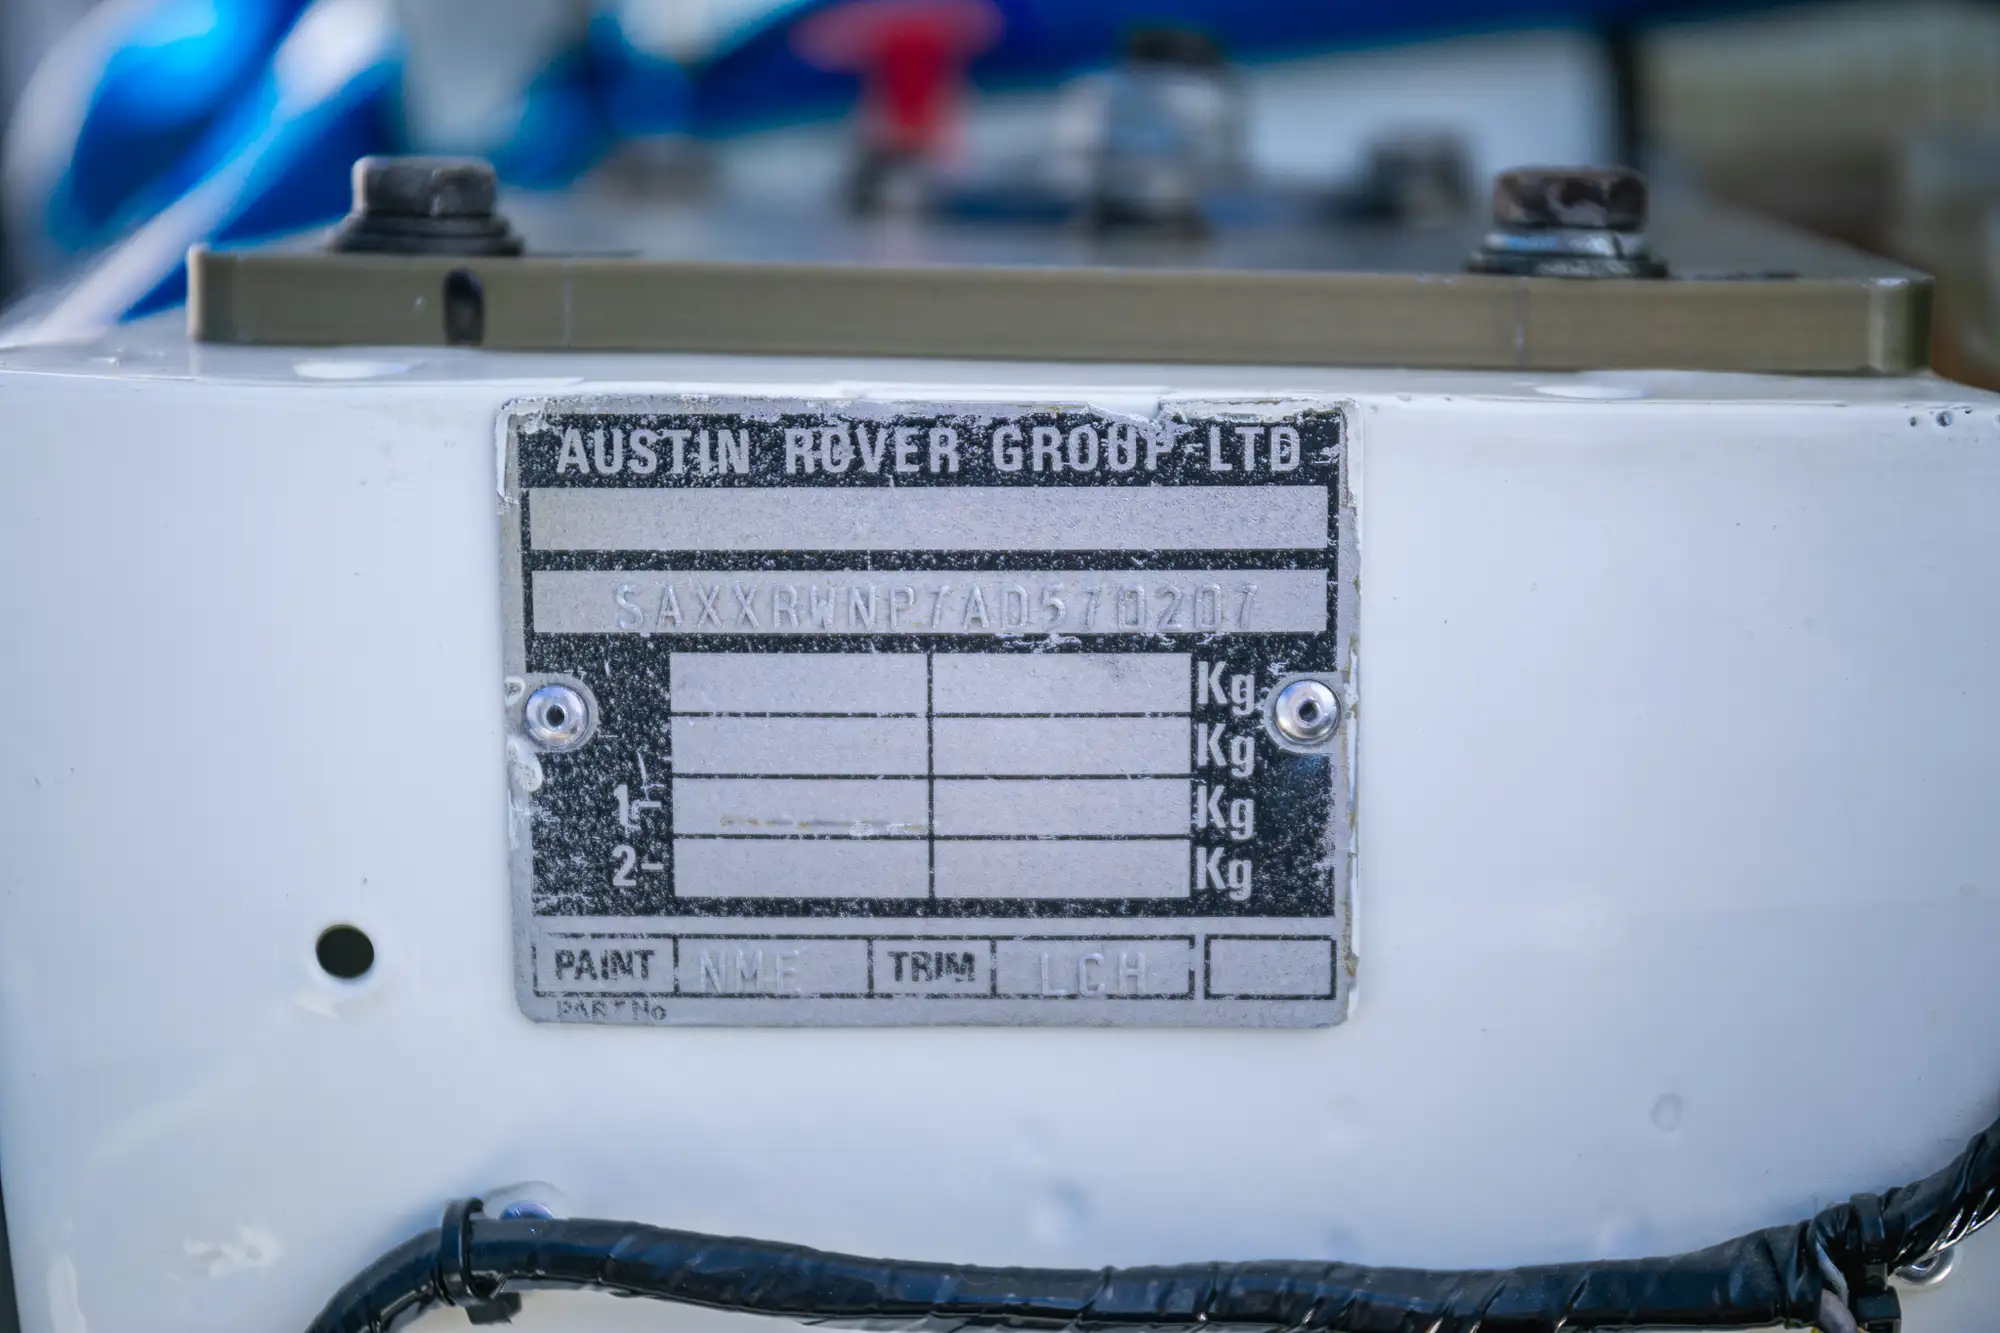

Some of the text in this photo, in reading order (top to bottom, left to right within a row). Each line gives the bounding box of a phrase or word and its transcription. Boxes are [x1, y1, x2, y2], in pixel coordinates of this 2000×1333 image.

[556, 423, 1301, 475] AUSTIN ROVER GROUP LTD
[1197, 661, 1255, 716] Kg
[1197, 723, 1255, 778] Kg
[1197, 785, 1254, 840] Kg
[1196, 847, 1253, 901] Kg
[554, 949, 655, 982] PAINT
[888, 951, 976, 983] TRIM
[1040, 951, 1146, 997] LCH
